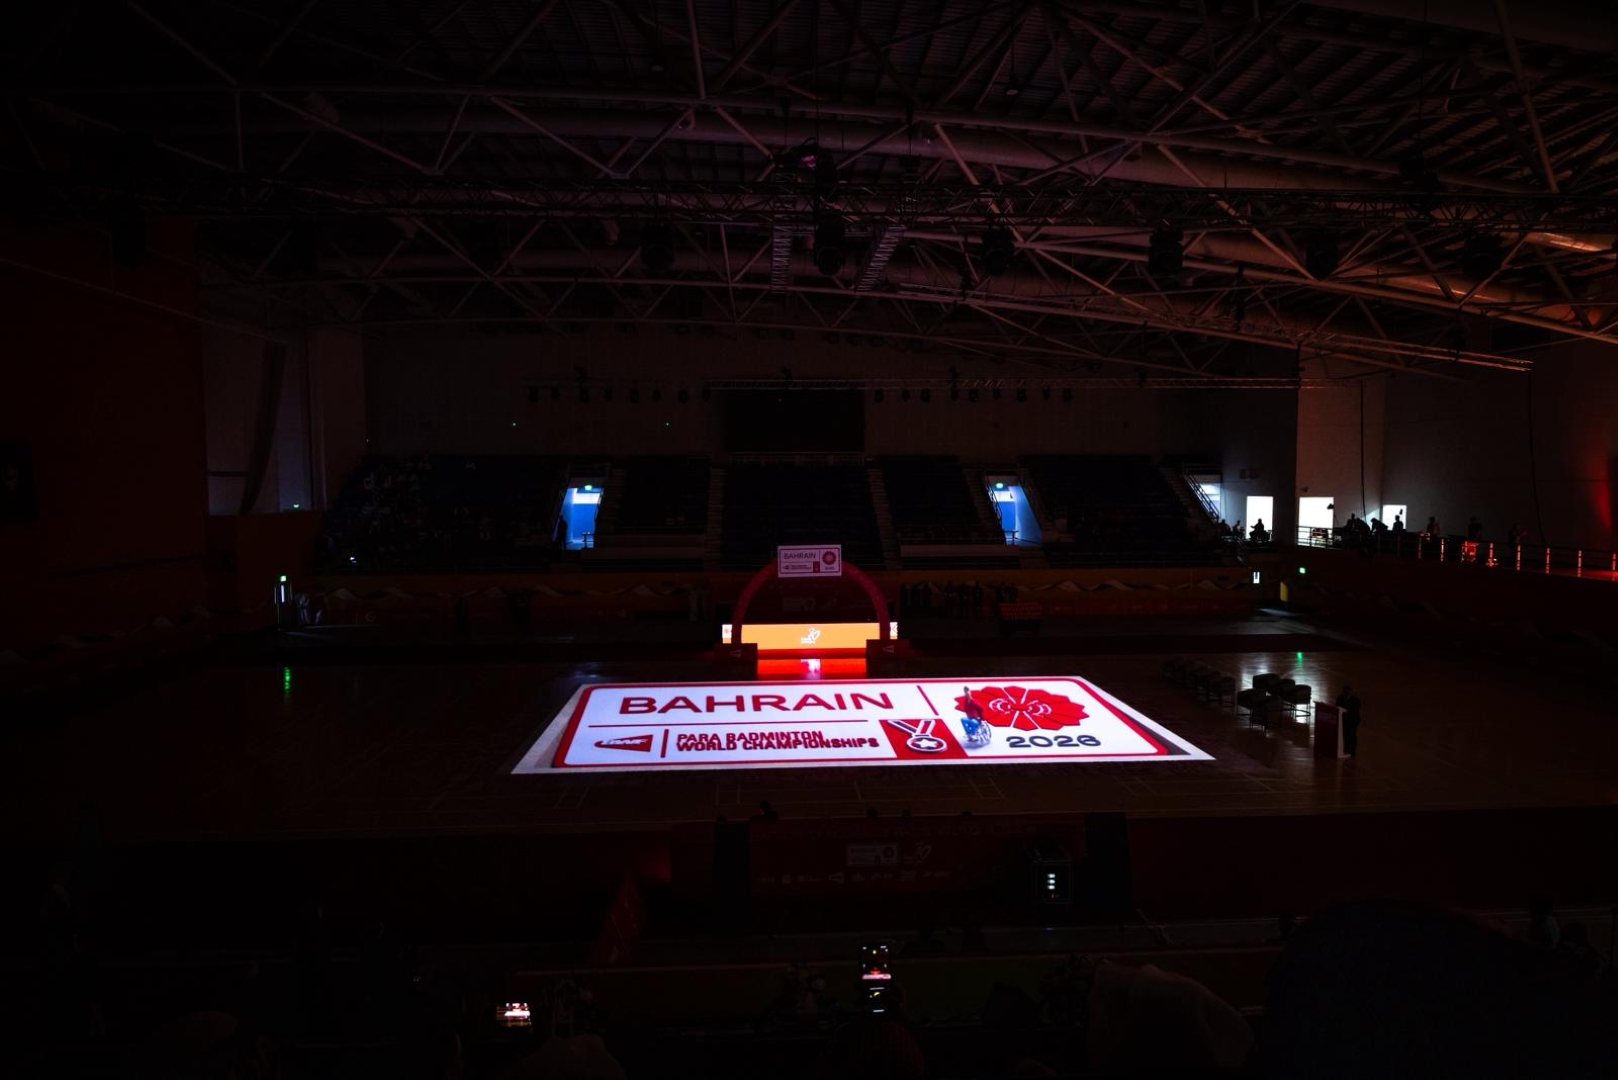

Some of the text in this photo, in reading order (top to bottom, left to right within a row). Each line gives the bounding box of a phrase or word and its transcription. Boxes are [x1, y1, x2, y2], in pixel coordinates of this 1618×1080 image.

[619, 693, 894, 714] BAHRAIN
[677, 731, 824, 742] PARA BADMINTON
[1006, 735, 1101, 748] 2026
[676, 738, 880, 751] WORLD CHAMPIONSHIPS
